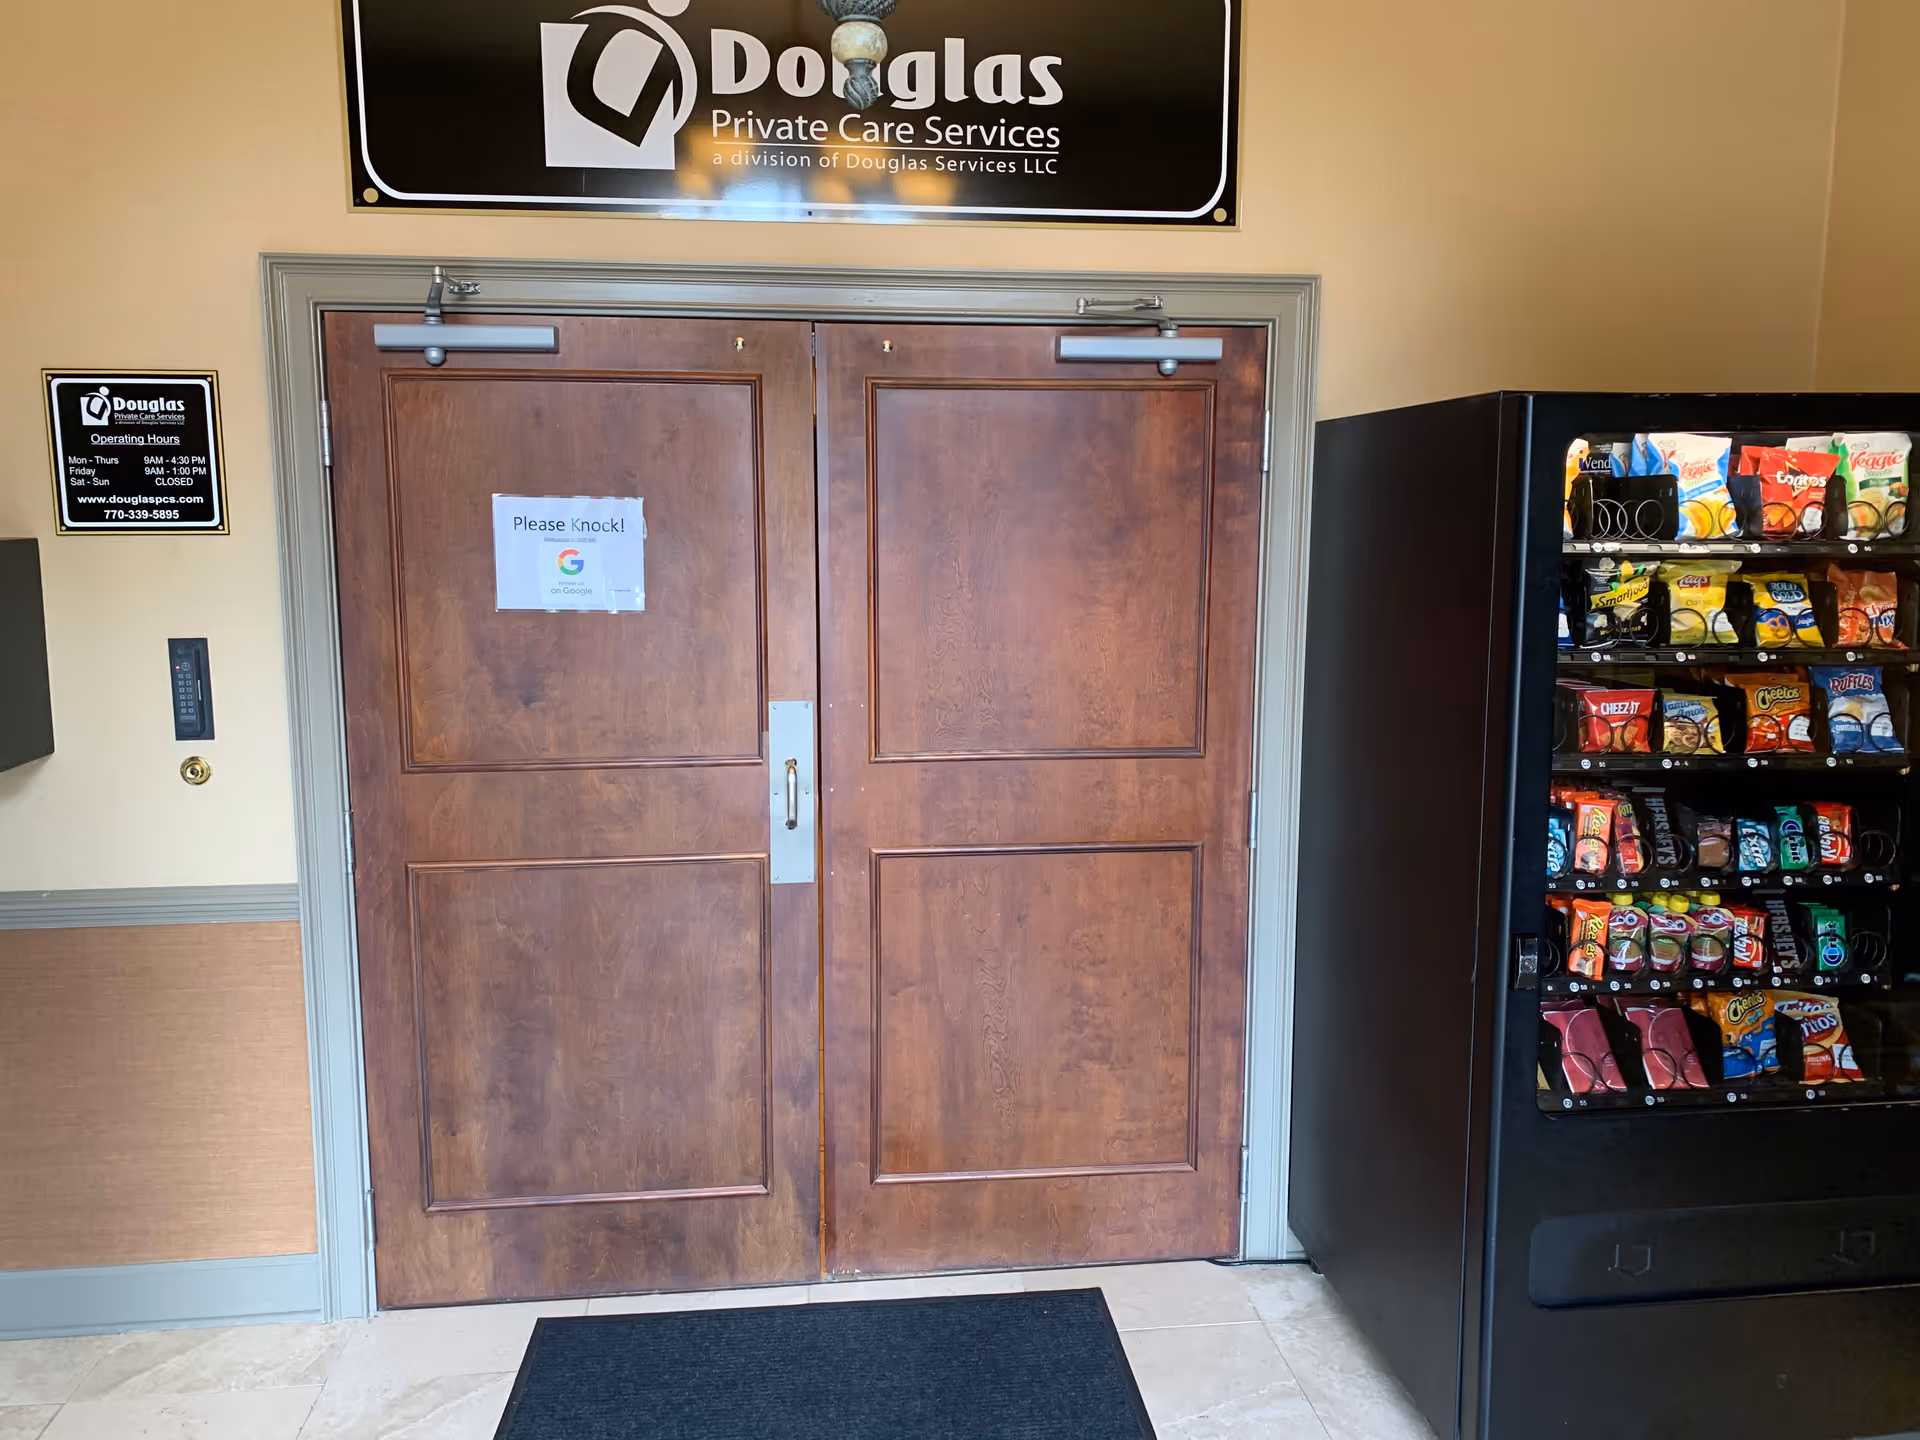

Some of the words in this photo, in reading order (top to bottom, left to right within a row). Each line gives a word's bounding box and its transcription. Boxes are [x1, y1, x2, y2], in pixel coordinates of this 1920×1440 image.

[712, 110, 828, 142] Private
[838, 113, 914, 145] Care
[924, 115, 1060, 149] Services
[712, 154, 722, 165] a
[731, 150, 811, 168] division
[818, 152, 839, 169] of
[846, 153, 928, 174] Douglas
[934, 156, 1018, 174] Services
[1024, 158, 1058, 175] LLC
[112, 396, 185, 413] Douglas
[91, 434, 144, 445] Operating
[148, 434, 180, 444] Hours
[68, 456, 87, 464] Mon
[94, 456, 119, 464] Thurs
[144, 456, 163, 464] 9AM
[171, 456, 189, 464] 4:30
[192, 456, 205, 464] PM
[1850, 451, 1904, 471] Veggie
[69, 467, 96, 476] Friday
[70, 478, 85, 486] Sat
[92, 478, 110, 486] Sun
[155, 478, 193, 486] CLOSED
[77, 495, 204, 506] www.douglaspcs.com
[104, 510, 179, 519] 770-339-5895
[513, 516, 565, 531] Please
[571, 518, 625, 532] Knock!
[1679, 576, 1708, 588] Lay's
[1771, 582, 1797, 591] ROLD
[563, 587, 592, 596] Google
[1596, 577, 1648, 608] Smartfood
[1772, 591, 1804, 601] GOLD
[1830, 674, 1874, 693] RUFFLES
[1757, 686, 1800, 710] Cheetos
[1678, 707, 1706, 718] Amos
[1645, 798, 1677, 864] HERSHEY'S
[1586, 914, 1604, 958] Reee's
[1766, 900, 1800, 968] HERSHEY'S
[1728, 990, 1764, 1022] Cheetos
[1798, 1014, 1837, 1037] ritos
